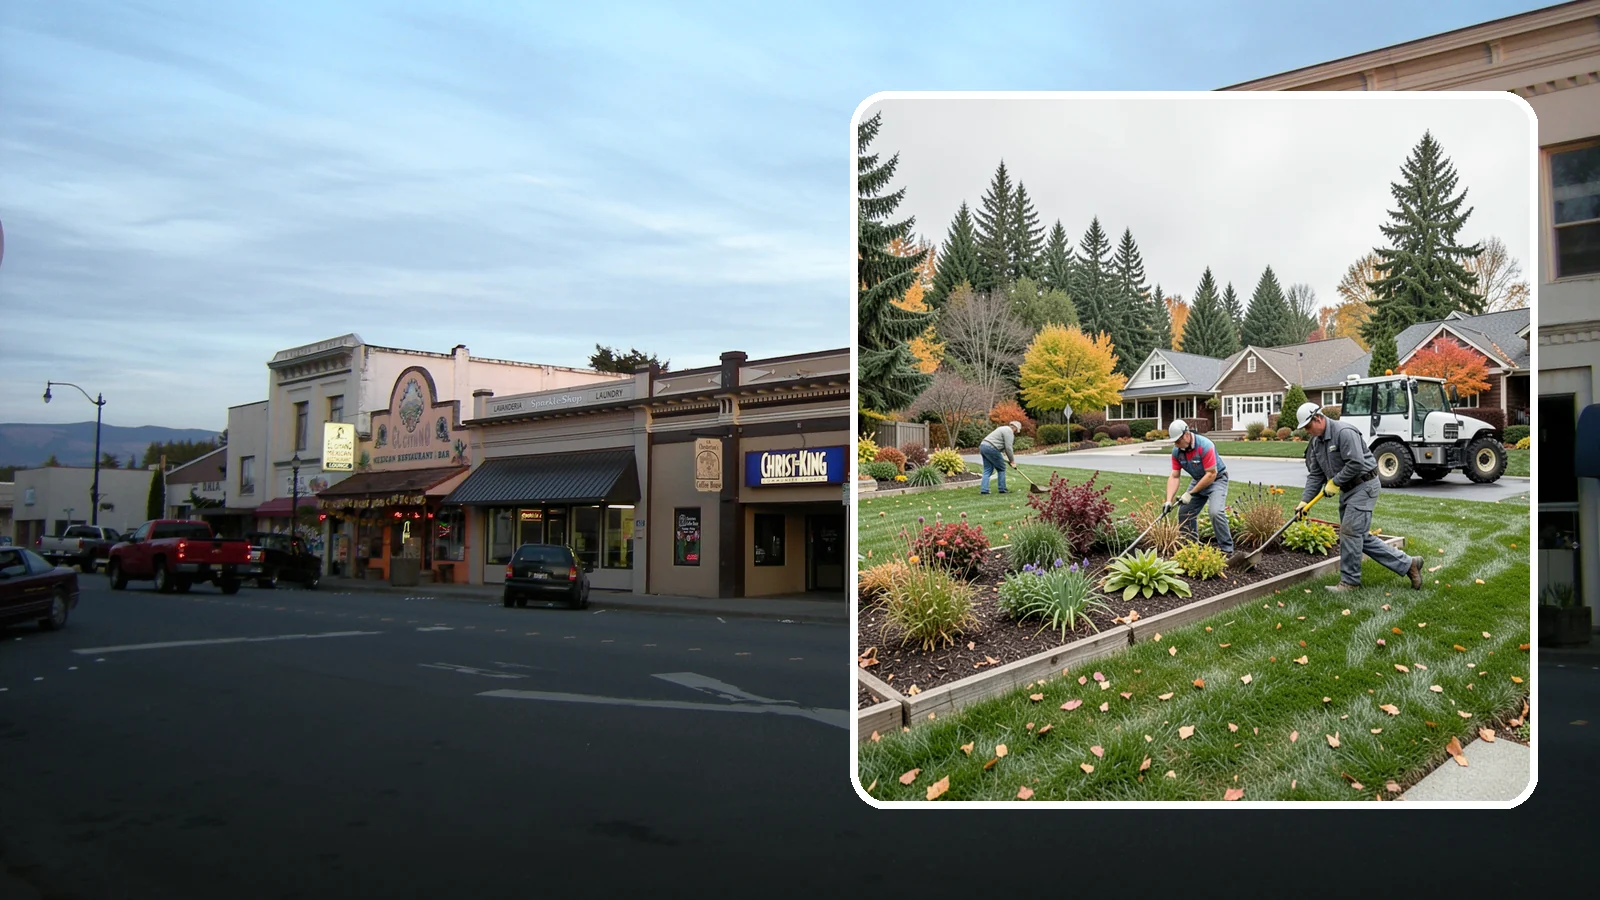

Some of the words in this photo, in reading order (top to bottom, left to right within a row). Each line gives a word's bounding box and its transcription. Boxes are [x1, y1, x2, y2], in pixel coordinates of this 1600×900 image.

[595, 389, 624, 400] LAUNDRY
[494, 402, 522, 412] LAVANDERIA
[531, 398, 561, 409] Sparkle
[561, 395, 584, 405] Shop
[374, 455, 396, 464] MEXICAN
[397, 451, 434, 462] RESTAURANT
[438, 450, 450, 460] BAR
[761, 452, 797, 477] CHRIST
[799, 450, 827, 476] KING
